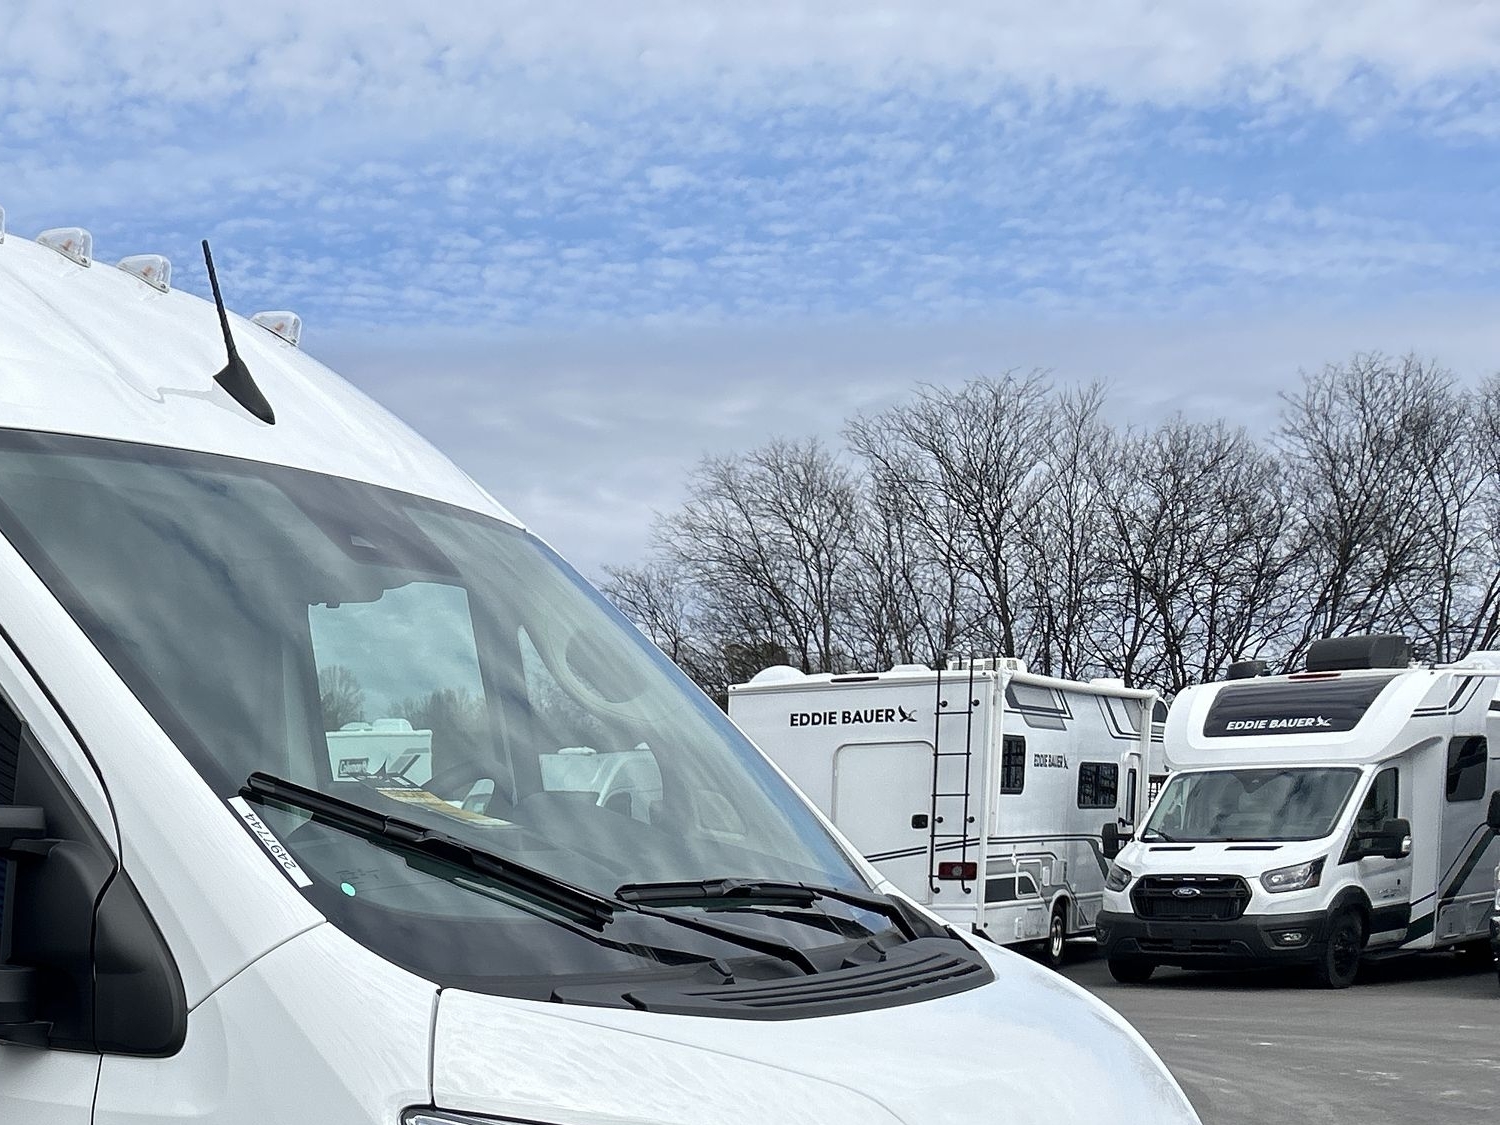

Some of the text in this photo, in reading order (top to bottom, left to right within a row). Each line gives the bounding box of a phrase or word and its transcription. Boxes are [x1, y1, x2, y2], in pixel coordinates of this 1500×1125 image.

[790, 708, 895, 727] EDDIE BAUER
[1226, 717, 1316, 730] EDDIE BAUER
[244, 812, 297, 870] 2497744
